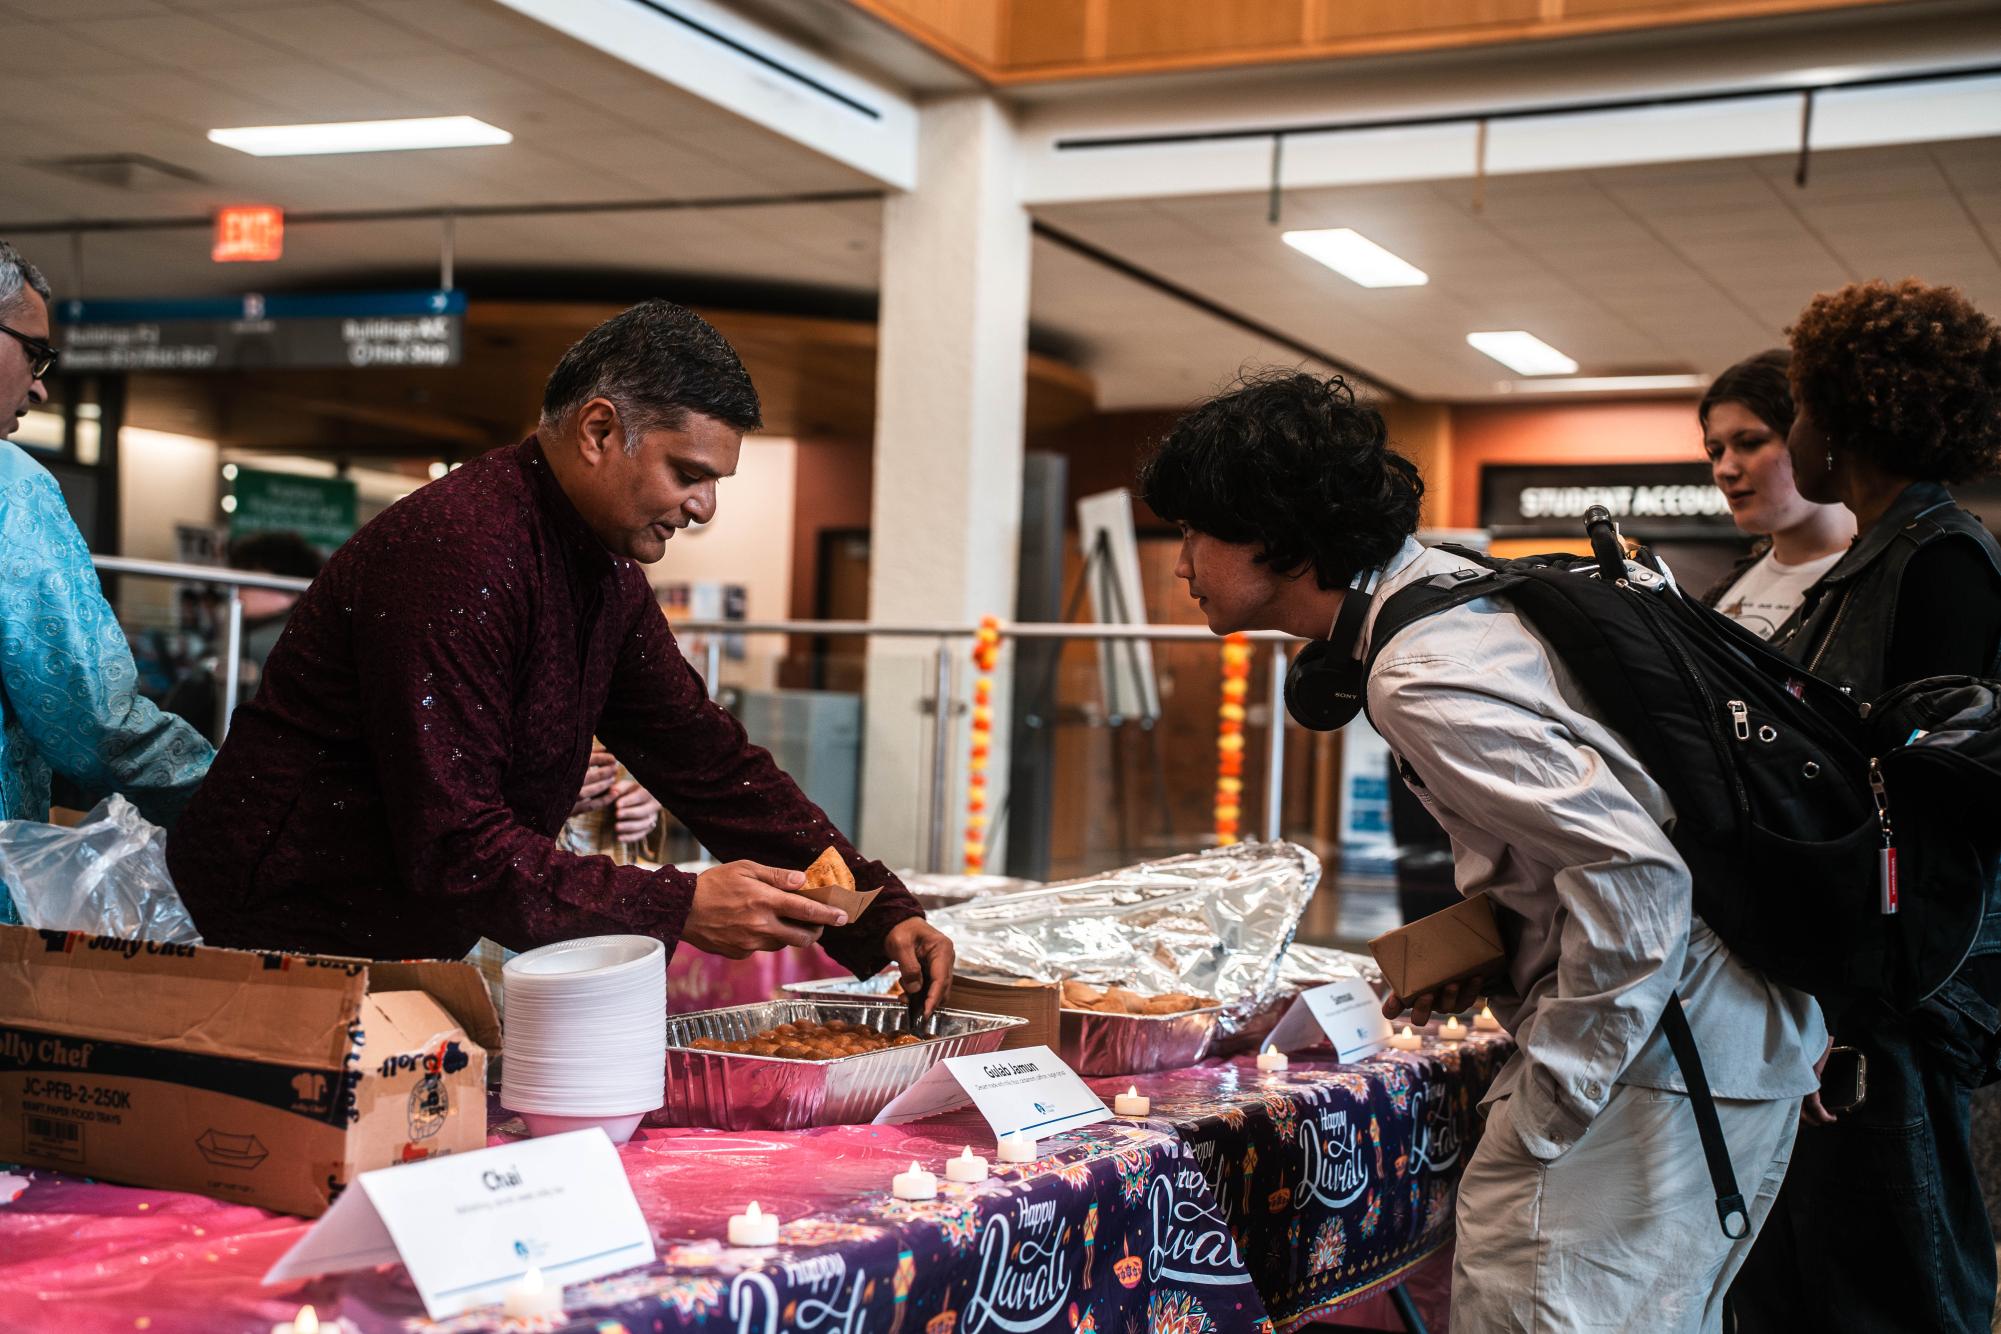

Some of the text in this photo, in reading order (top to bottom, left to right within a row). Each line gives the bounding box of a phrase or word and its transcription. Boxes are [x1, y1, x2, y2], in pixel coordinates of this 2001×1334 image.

[1519, 486, 1634, 517] STUDENT
[1334, 692, 1357, 700] SONY
[0, 1032, 94, 1069] lly Chef
[983, 1062, 1039, 1079] Gulab Jamun
[1319, 1107, 1347, 1137] Happy
[482, 1163, 523, 1191] Chai
[1294, 1119, 1368, 1209] Diwali
[1017, 1196, 1057, 1240] Happy
[775, 1252, 846, 1296] Happy
[962, 1213, 1072, 1334] Diwali
